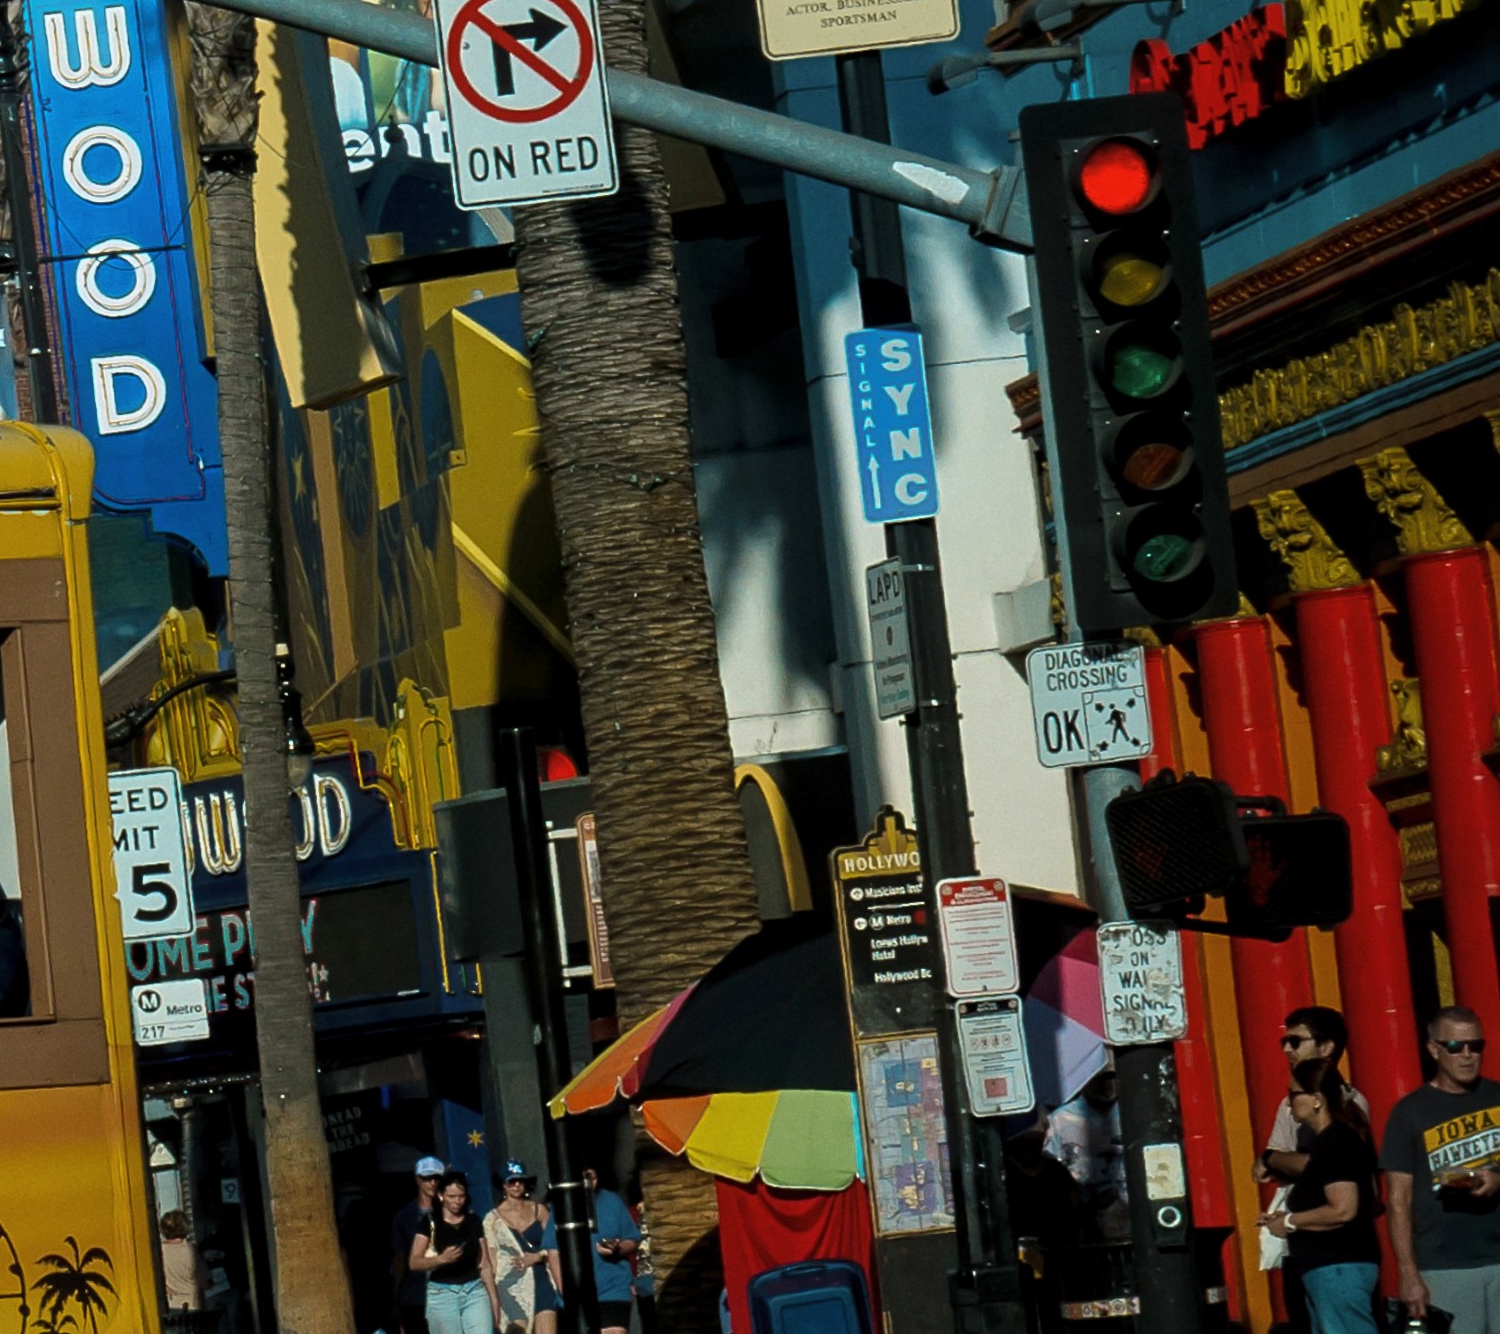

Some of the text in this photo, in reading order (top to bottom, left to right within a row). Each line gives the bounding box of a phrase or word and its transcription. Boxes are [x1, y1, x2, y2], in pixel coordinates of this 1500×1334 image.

[820, 9, 898, 28] SPORTSMAN
[468, 136, 599, 182] ON RED
[854, 343, 877, 448] SIGNAL
[880, 337, 929, 507] SYNC
[868, 569, 901, 605] LAPD
[1046, 664, 1128, 692] CROSSING
[1043, 709, 1085, 754] OK
[885, 914, 912, 926] Metro
[166, 1002, 202, 1016] Metro
[141, 1025, 165, 1039] 217
[1435, 1110, 1495, 1145] IOWA
